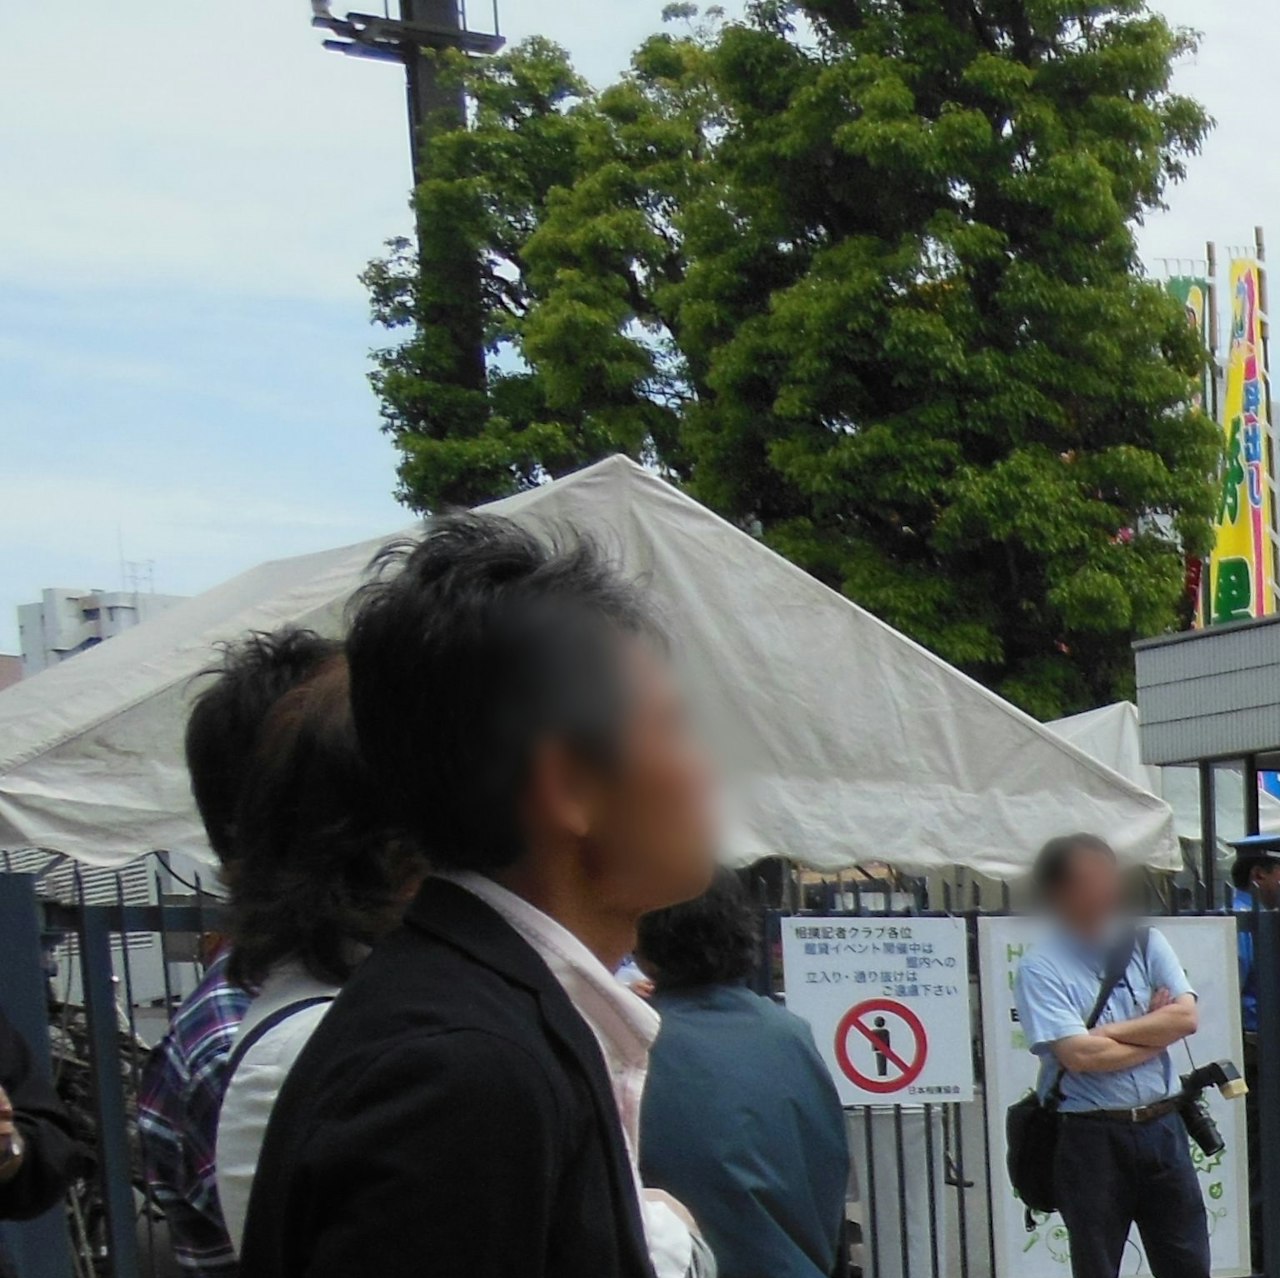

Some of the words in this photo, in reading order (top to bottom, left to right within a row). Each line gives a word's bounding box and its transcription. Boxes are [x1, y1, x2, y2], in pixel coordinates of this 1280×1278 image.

[795, 927, 913, 940] 相撲記者クラブ各位
